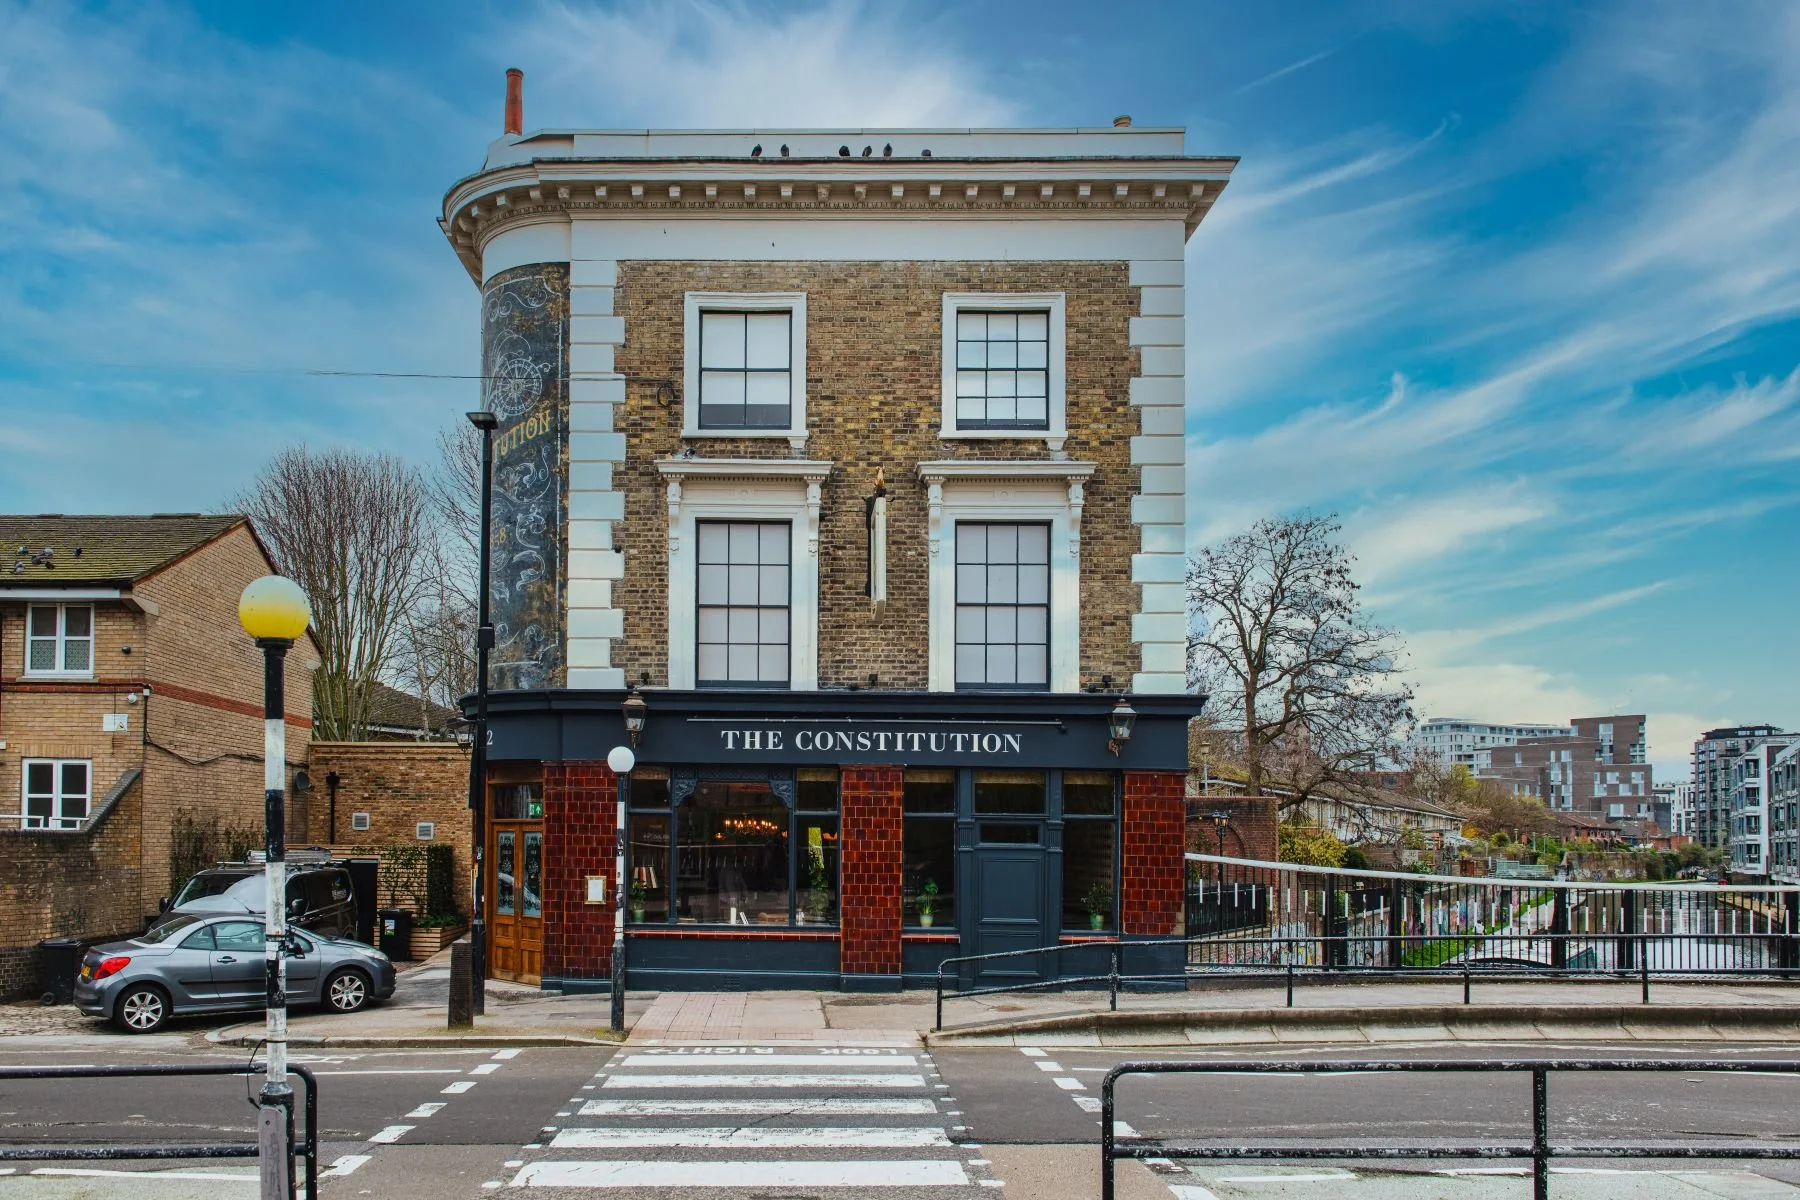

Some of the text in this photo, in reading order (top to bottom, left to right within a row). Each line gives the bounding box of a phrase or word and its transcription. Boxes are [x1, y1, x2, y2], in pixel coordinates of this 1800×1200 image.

[721, 730, 1022, 753] THE CONSTITUTION
[668, 1047, 898, 1055] LOOK RIGHT
